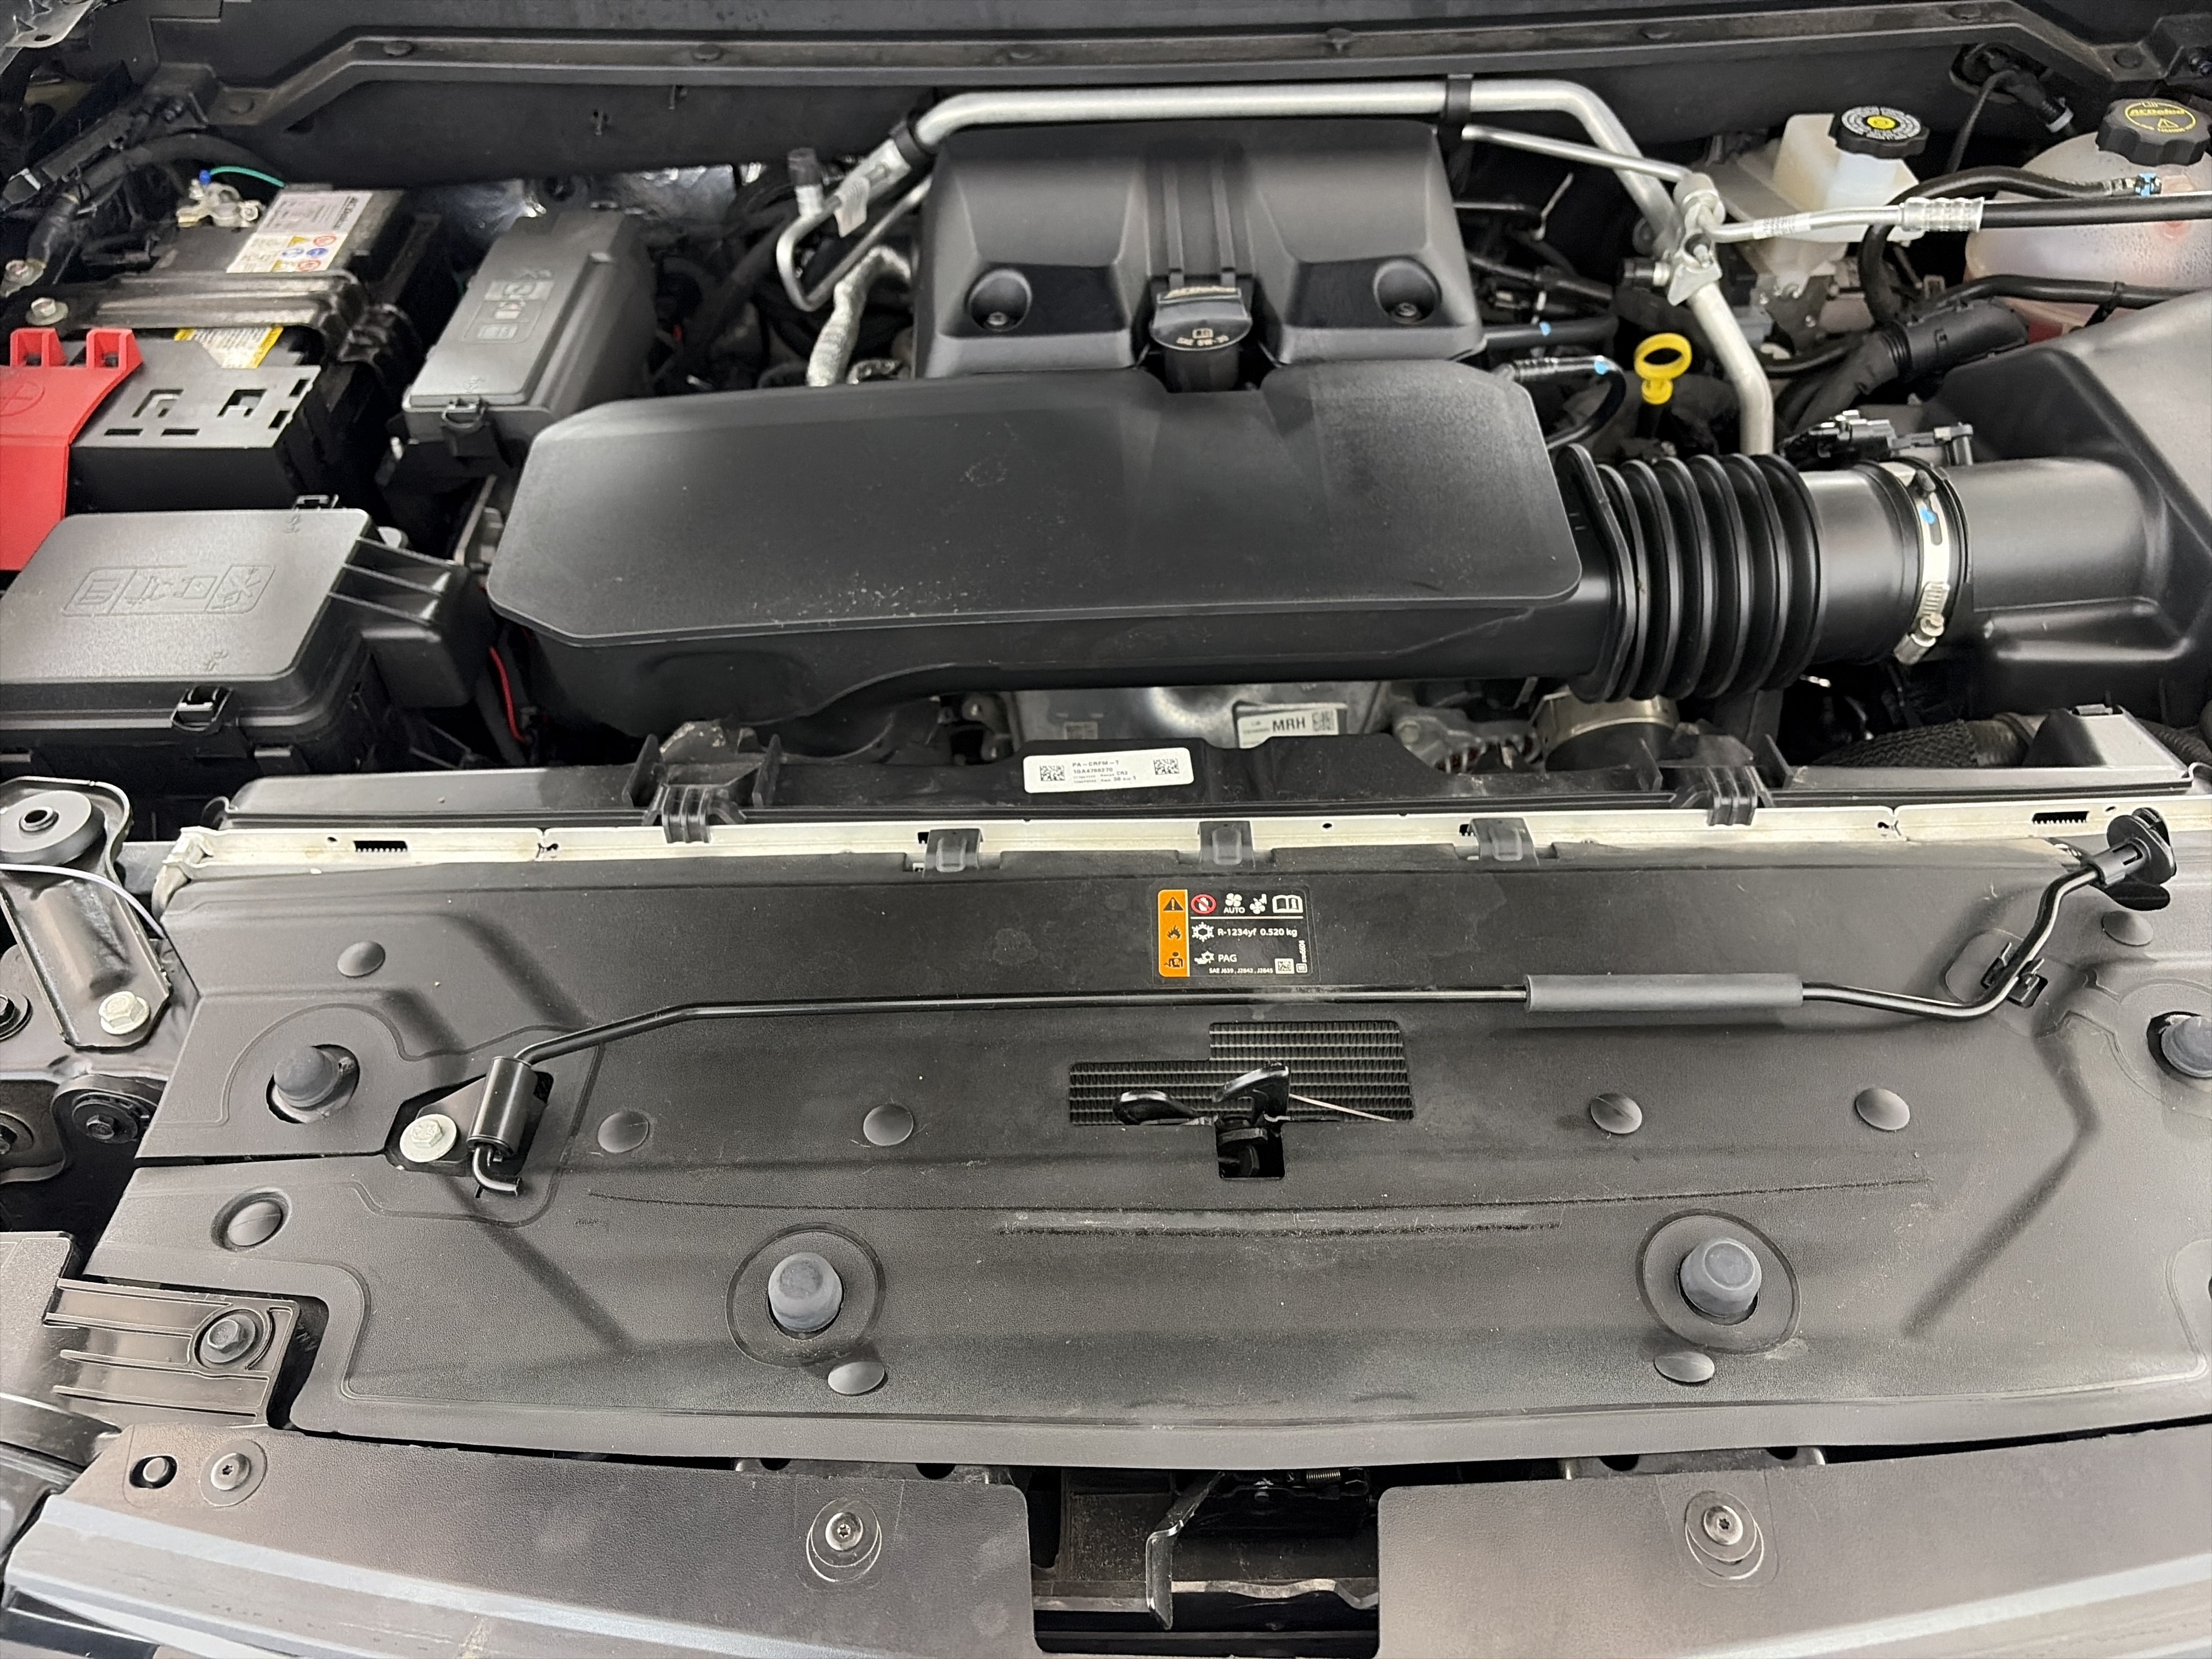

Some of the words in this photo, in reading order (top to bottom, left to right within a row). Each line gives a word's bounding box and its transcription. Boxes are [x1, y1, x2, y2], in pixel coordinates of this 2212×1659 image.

[1272, 716, 1306, 732] MRH
[1217, 928, 1257, 938] R-1234yf
[1260, 928, 1285, 936] 0.520
[1286, 928, 1297, 938] kg
[1218, 953, 1237, 962] PAG
